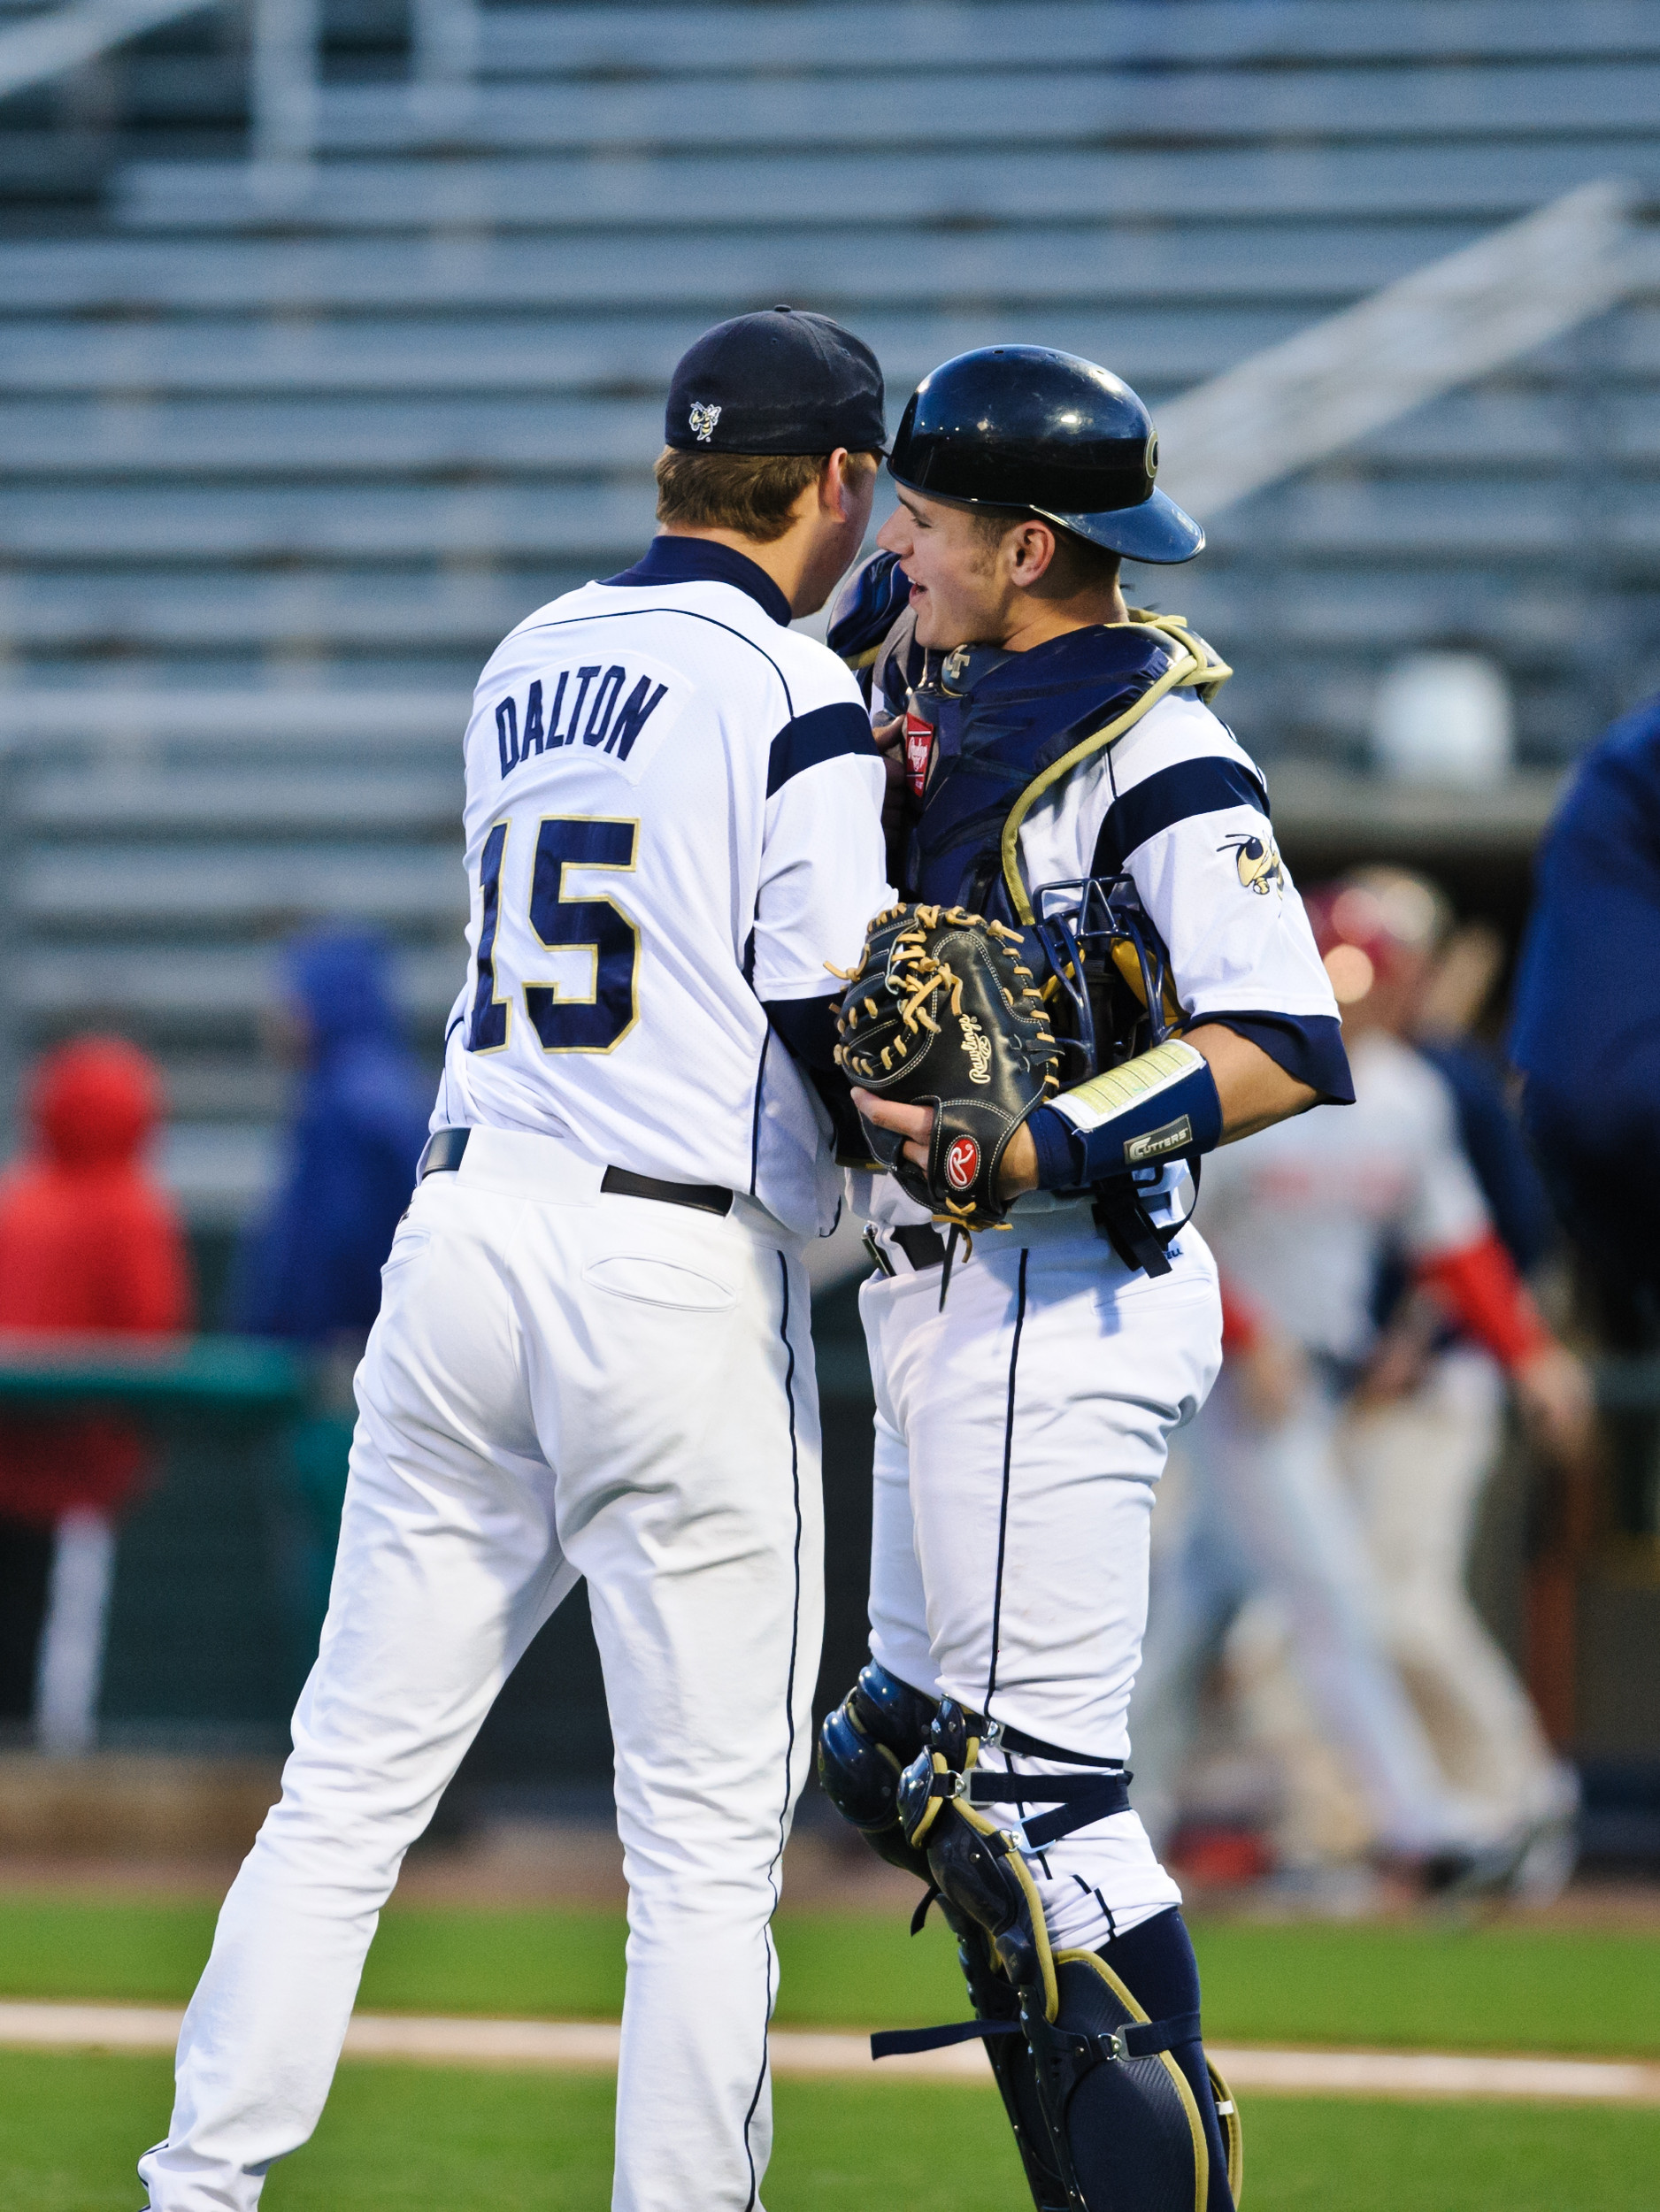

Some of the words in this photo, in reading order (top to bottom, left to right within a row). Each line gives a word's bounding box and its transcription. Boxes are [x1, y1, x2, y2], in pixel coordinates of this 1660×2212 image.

[495, 665, 669, 780] DALTON
[467, 814, 642, 1056] 15
[958, 1013, 992, 1084] Rawlings
[1129, 1129, 1187, 1160] CUTTERS
